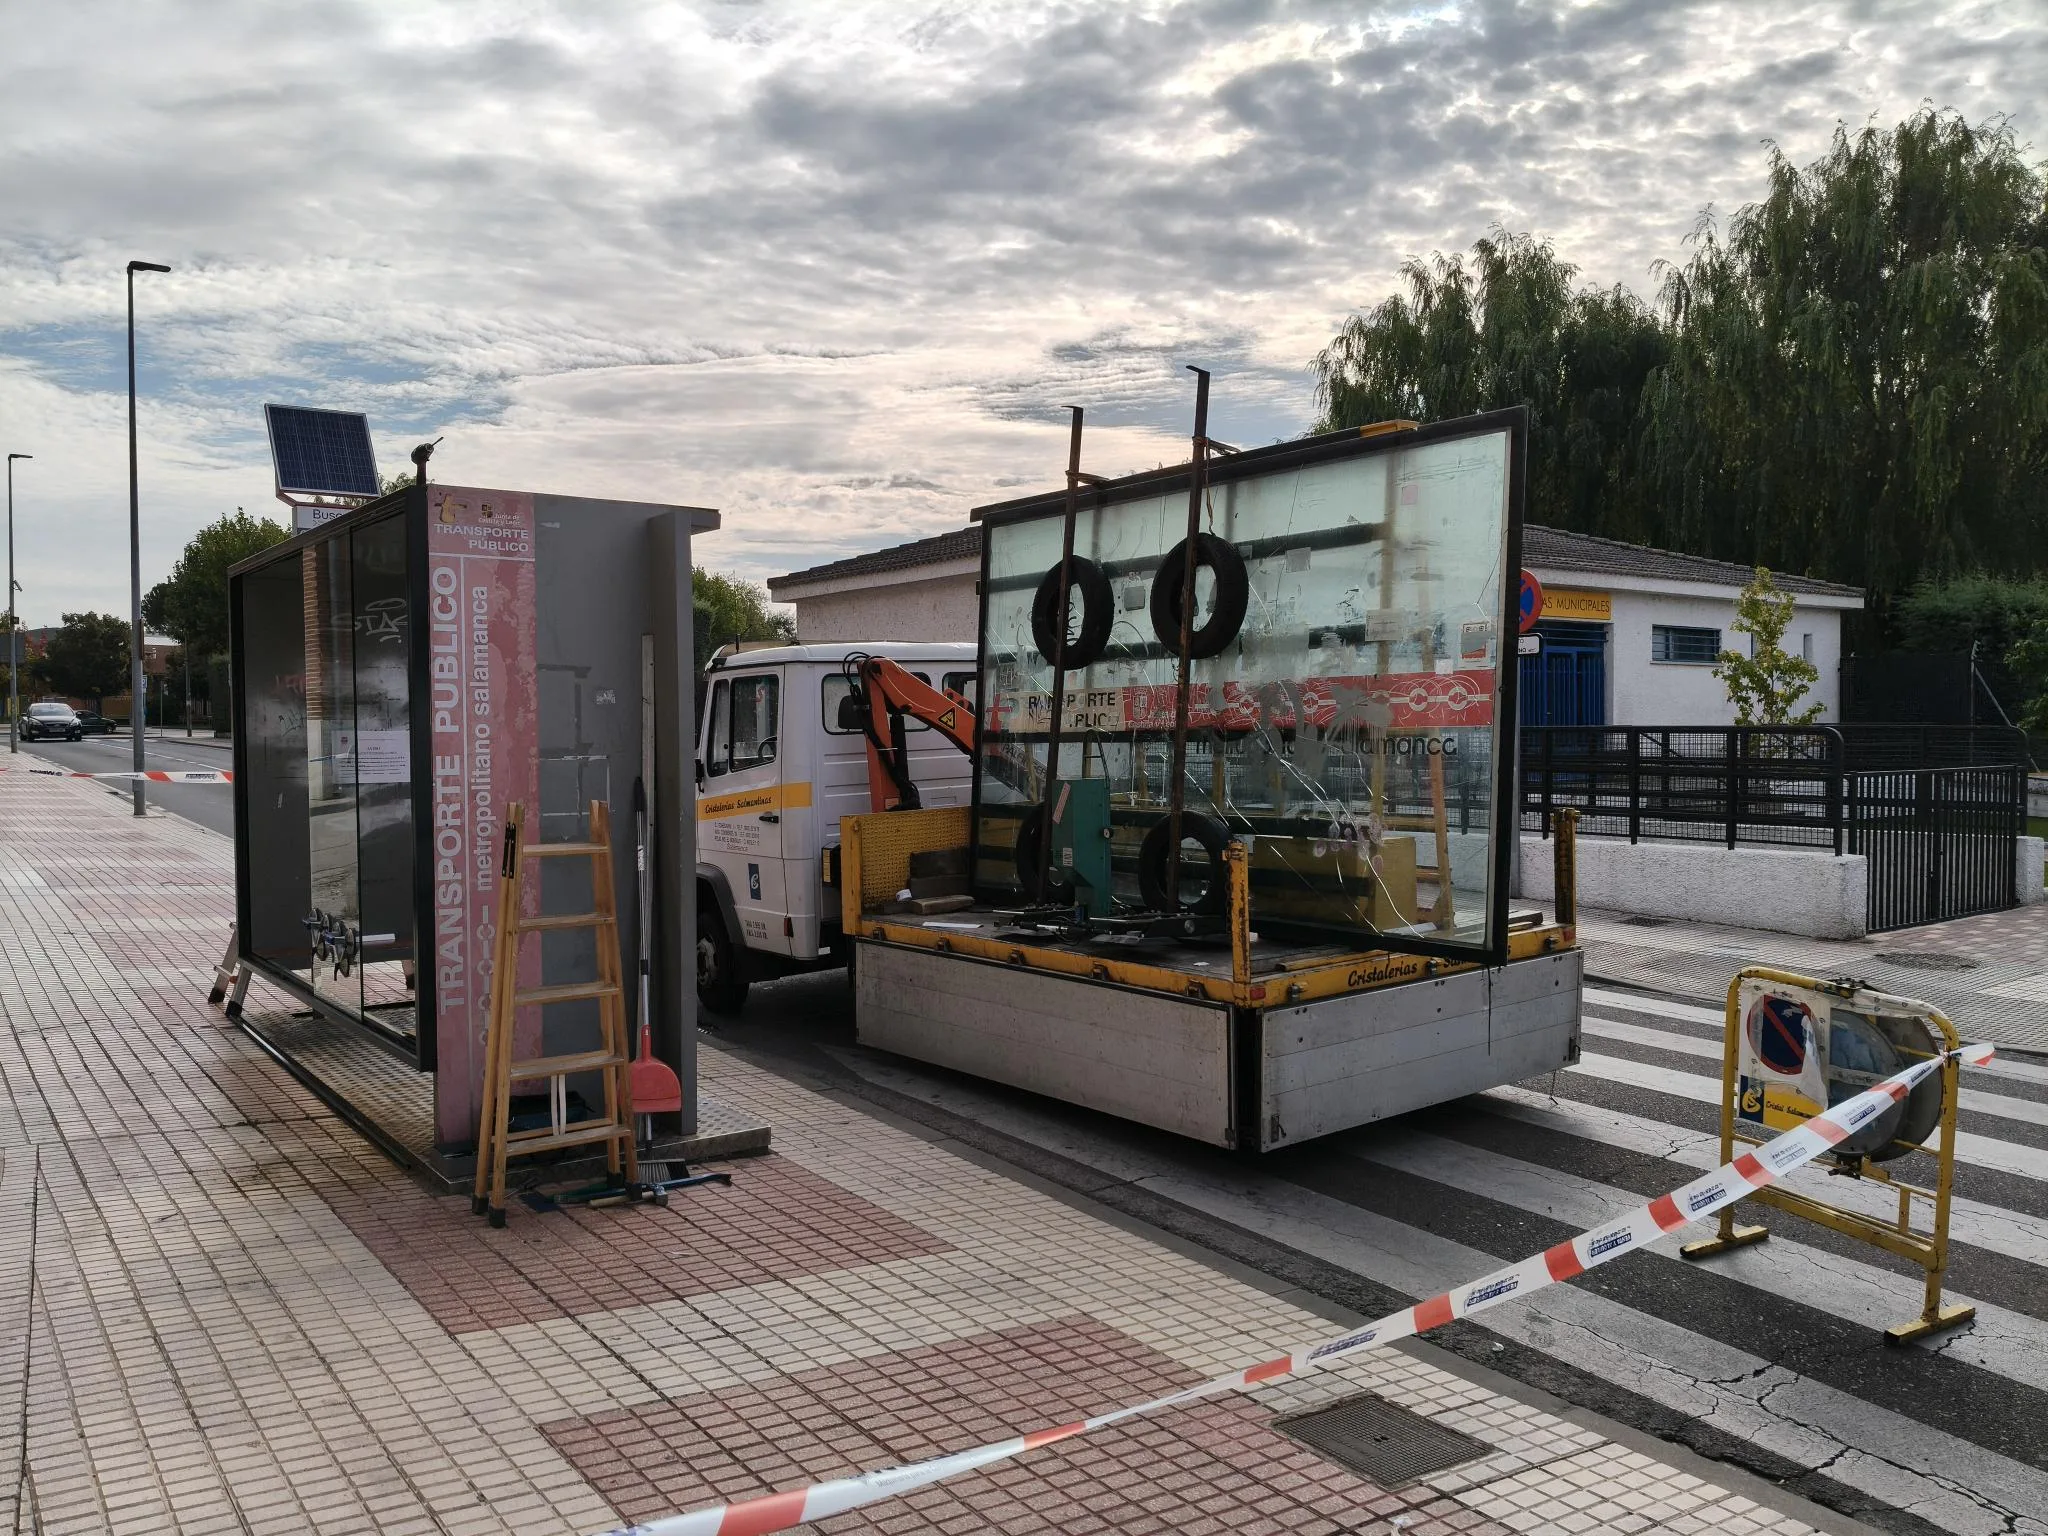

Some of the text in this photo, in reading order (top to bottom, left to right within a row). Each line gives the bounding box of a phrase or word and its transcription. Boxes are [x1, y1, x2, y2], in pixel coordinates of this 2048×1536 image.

[433, 523, 529, 539] TRANSPORTE
[1556, 597, 1610, 613] MUNICIPALES
[470, 586, 497, 891] metropolitano salamanca
[435, 755, 465, 1015] TRANSPORTE
[1347, 962, 1418, 987] Cristalerias
